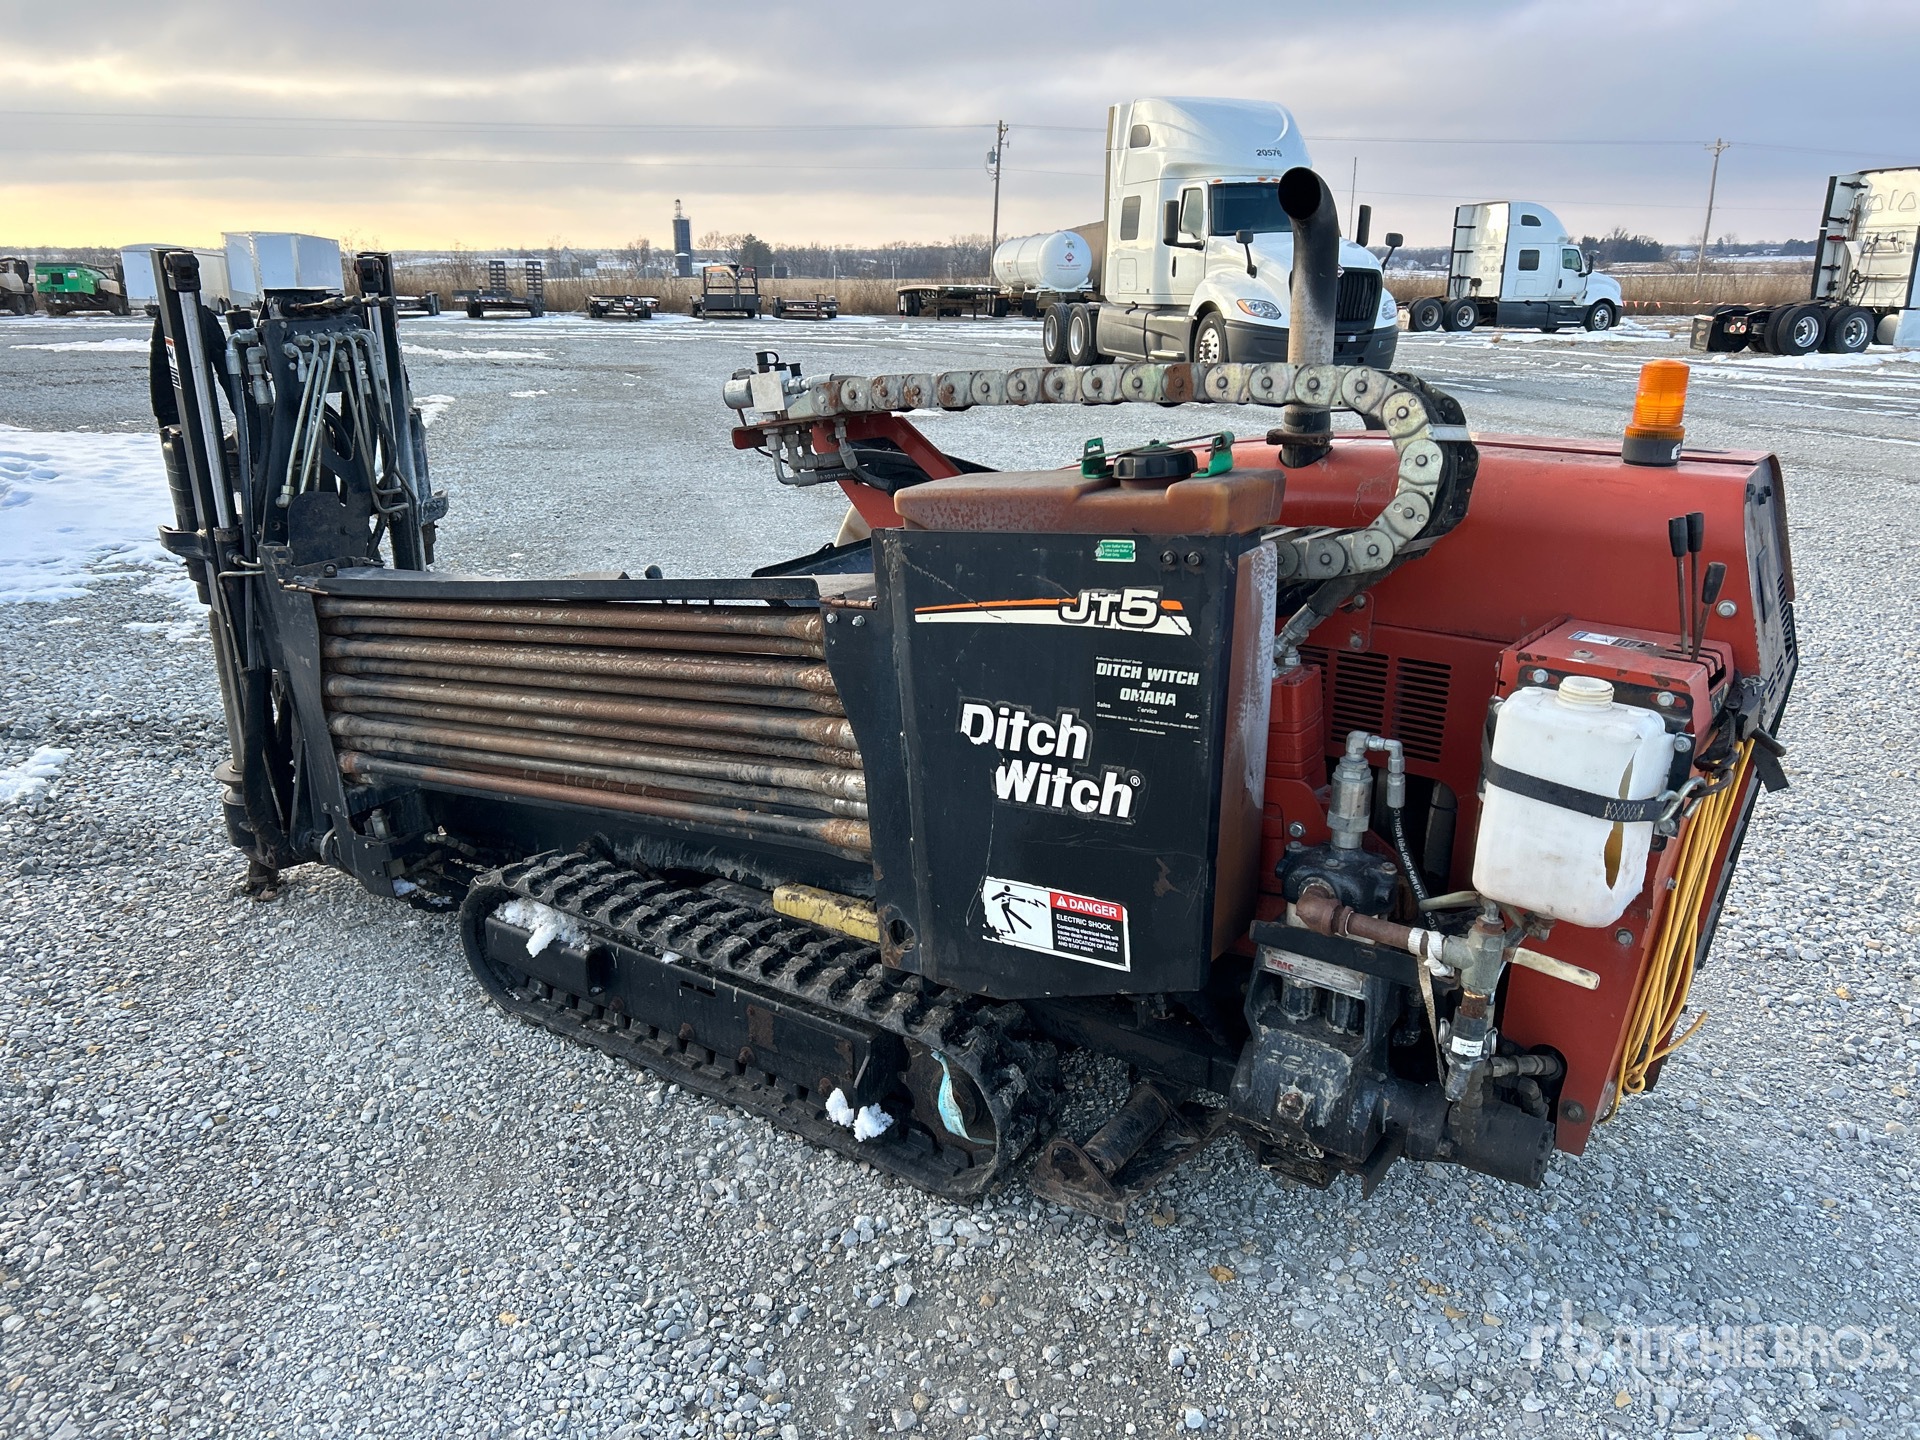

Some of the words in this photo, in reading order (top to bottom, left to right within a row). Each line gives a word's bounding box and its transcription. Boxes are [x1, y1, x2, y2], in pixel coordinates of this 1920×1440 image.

[1062, 588, 1158, 624] JT5
[1096, 662, 1142, 679] DITCH
[1147, 668, 1199, 686] WITCH
[1120, 688, 1176, 706] OMAHA
[960, 704, 1088, 759] Ditch
[1069, 899, 1117, 917] DANGER
[1056, 914, 1087, 926] ELECTRIC
[1088, 920, 1113, 931] SHOCK.
[1073, 938, 1096, 947] LOCATION
